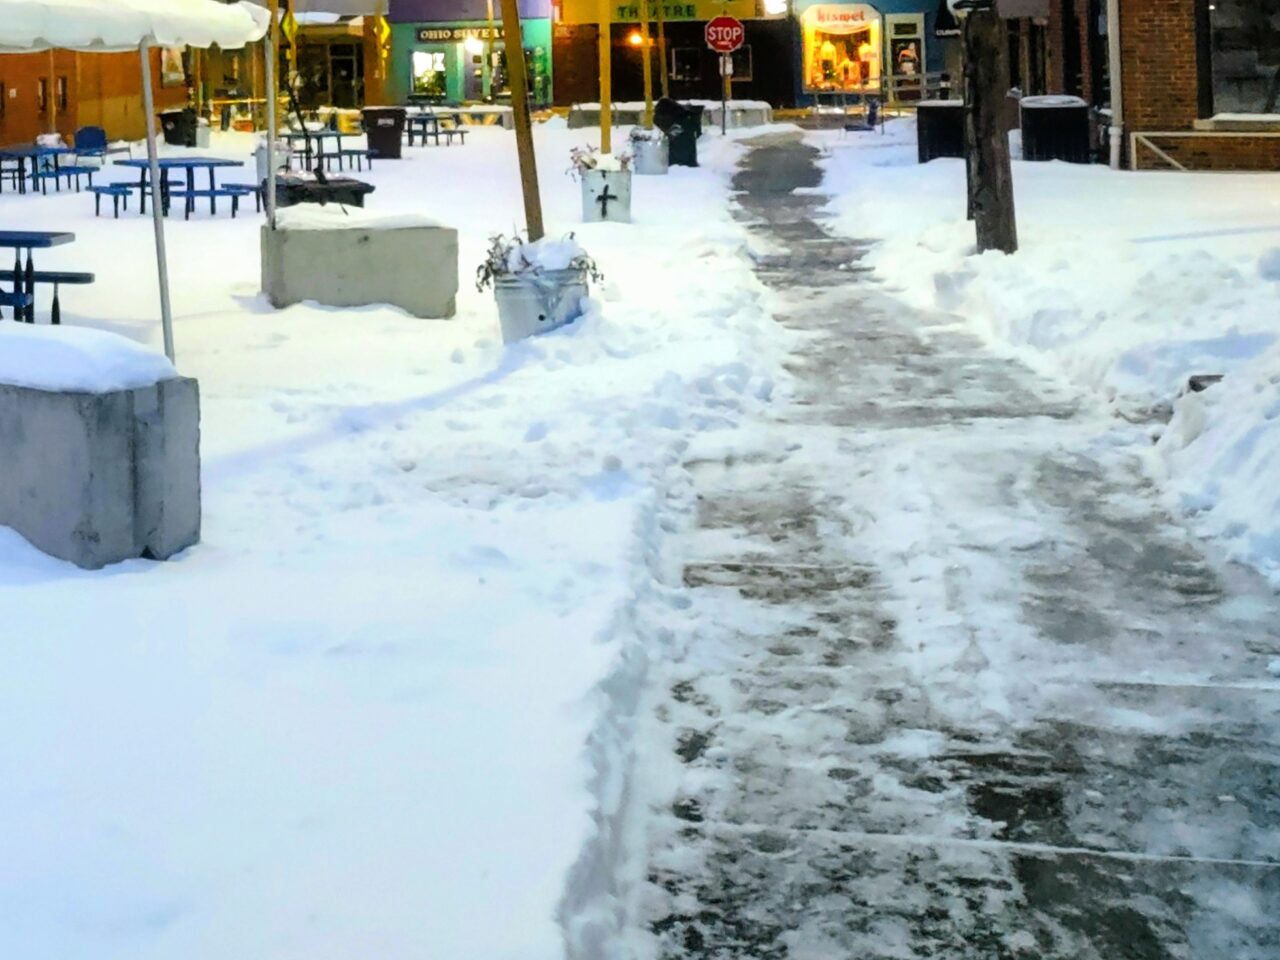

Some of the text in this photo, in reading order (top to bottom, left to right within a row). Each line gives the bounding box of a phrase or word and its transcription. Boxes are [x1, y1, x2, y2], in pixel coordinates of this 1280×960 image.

[618, 5, 695, 18] THATRE
[420, 29, 451, 40] OHIO
[708, 26, 741, 41] STOP
